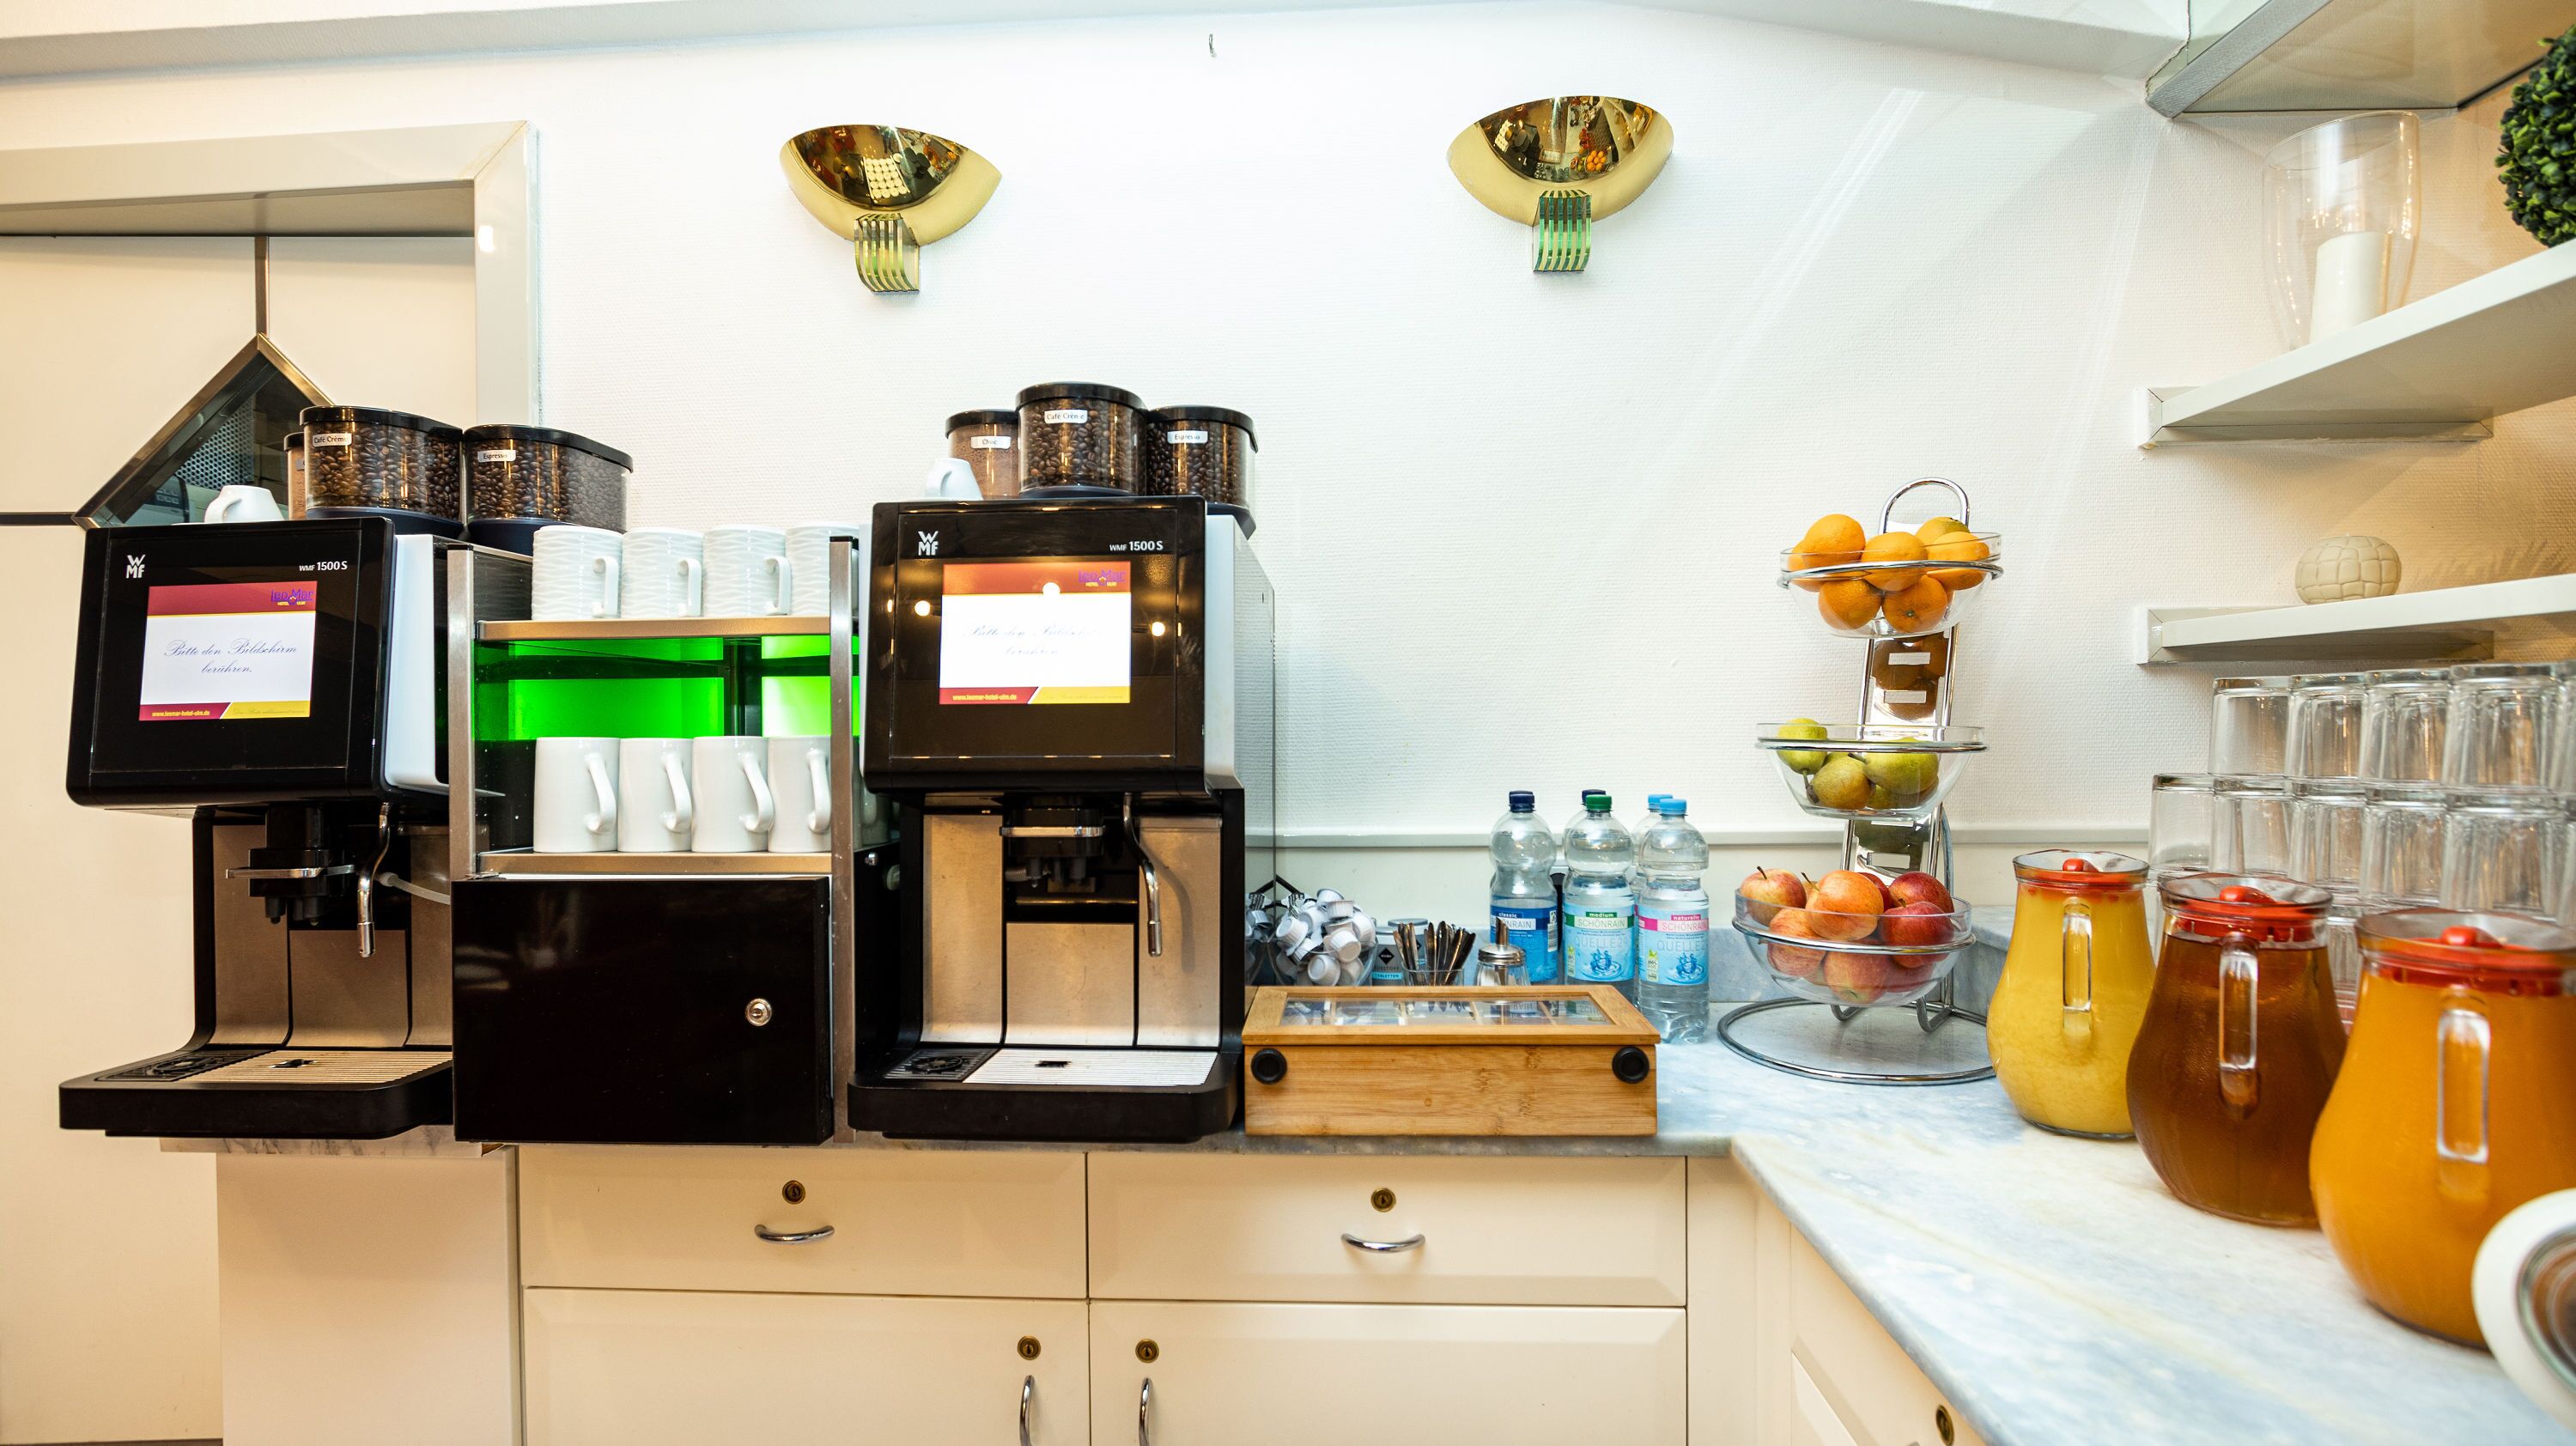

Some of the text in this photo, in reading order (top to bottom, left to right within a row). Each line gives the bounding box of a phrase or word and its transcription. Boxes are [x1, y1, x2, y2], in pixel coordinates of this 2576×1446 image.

[918, 530, 939, 556] WMF
[126, 554, 146, 579] WMF
[164, 637, 297, 657] Bitte den Bildschirm
